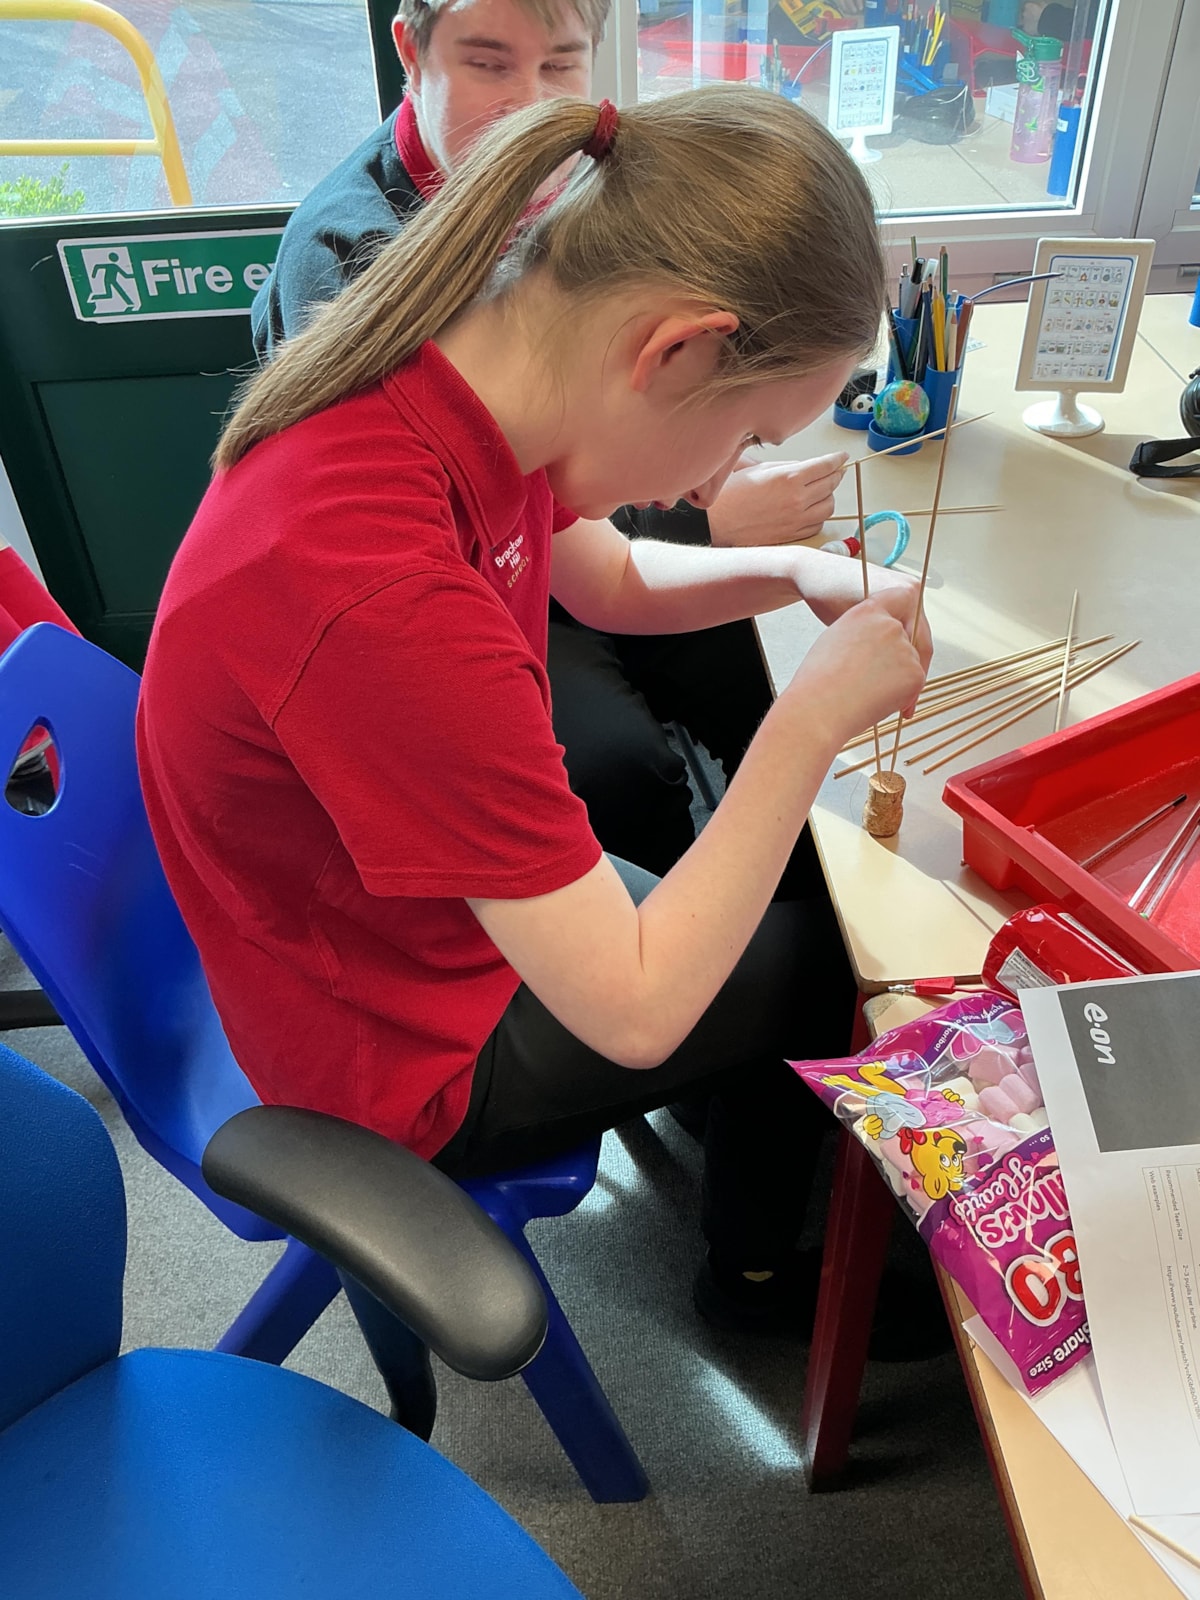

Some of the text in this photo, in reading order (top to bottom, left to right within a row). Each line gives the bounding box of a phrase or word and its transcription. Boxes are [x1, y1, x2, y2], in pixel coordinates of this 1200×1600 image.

[141, 258, 276, 297] Fire e
[494, 534, 524, 568] Bracken
[954, 1157, 1033, 1221] Hearts
[979, 1172, 1069, 1243] llows
[1148, 1170, 1161, 1212] Web examples
[1165, 1169, 1180, 1212] Recommended
[1183, 1277, 1193, 1296] pupils
[1029, 1356, 1054, 1377] Size
